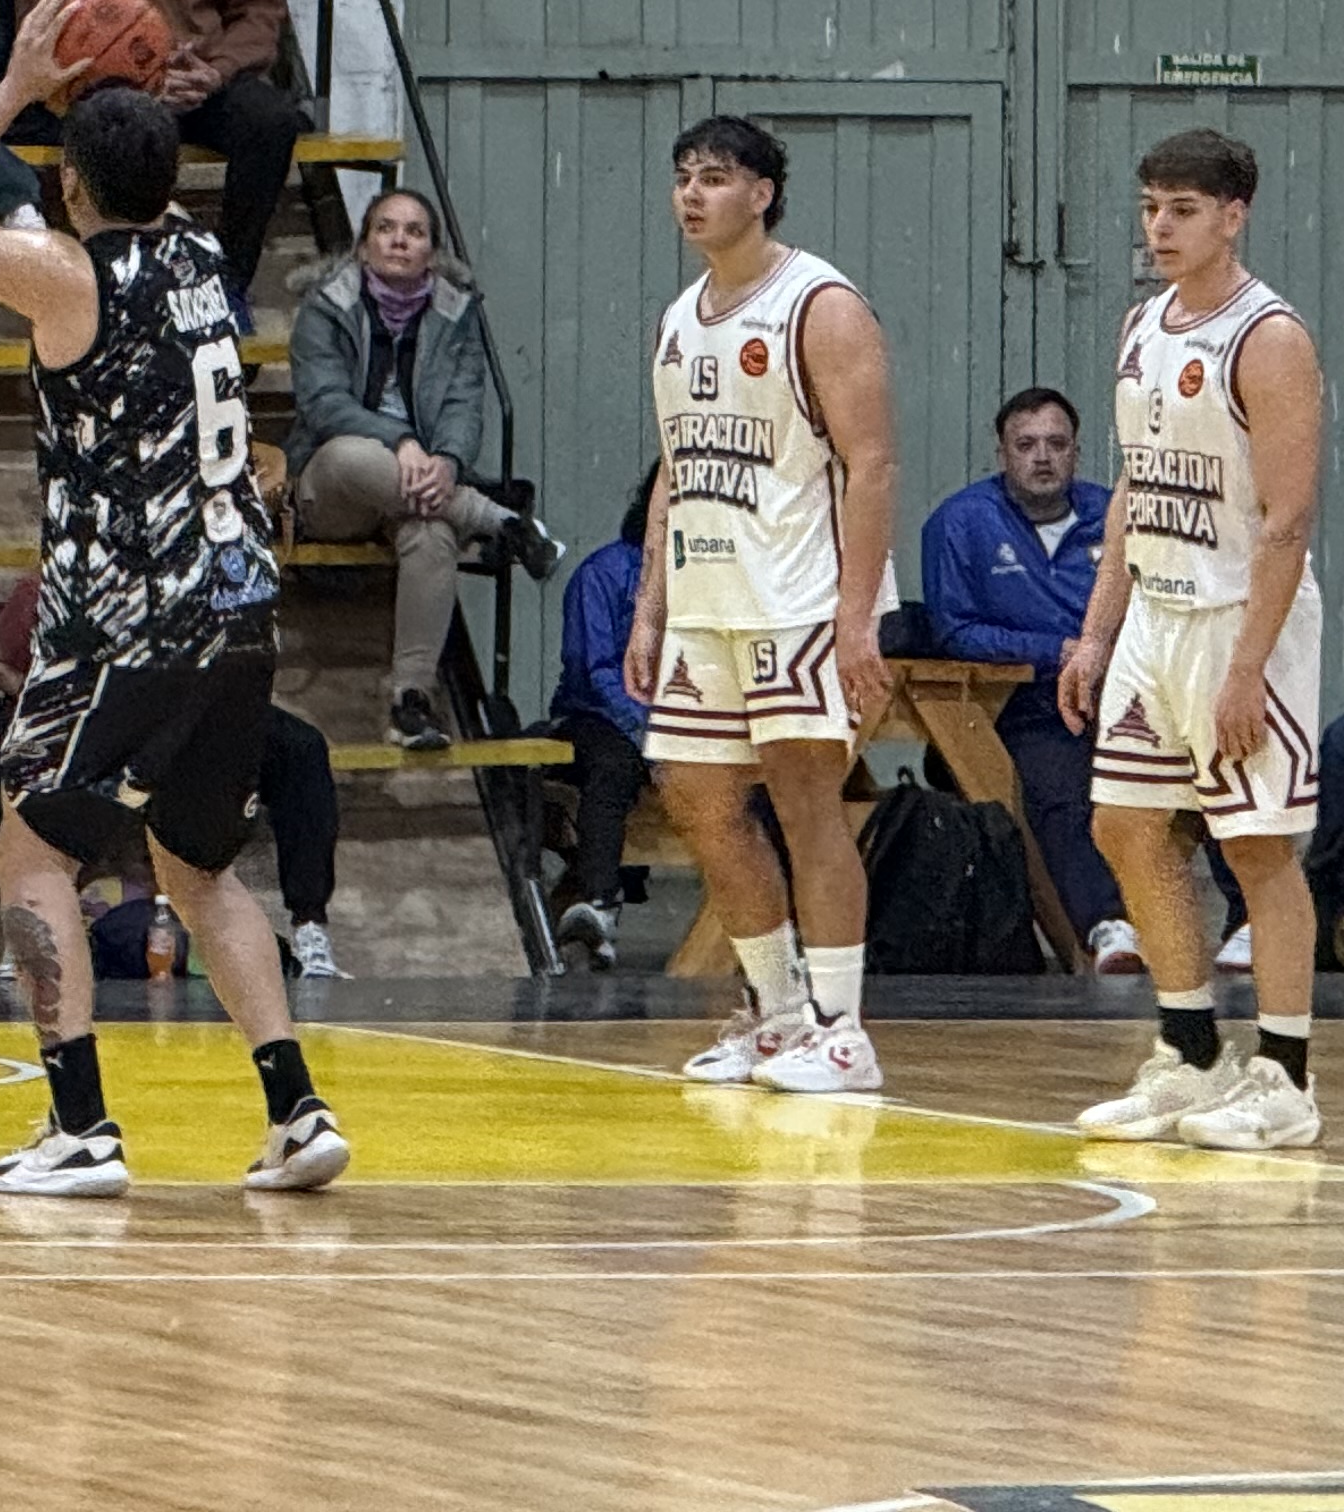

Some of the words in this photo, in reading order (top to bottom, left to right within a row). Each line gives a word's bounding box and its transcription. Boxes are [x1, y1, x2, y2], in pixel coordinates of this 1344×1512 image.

[689, 355, 719, 402] 15
[192, 335, 249, 488] 6
[748, 639, 777, 684] 15
